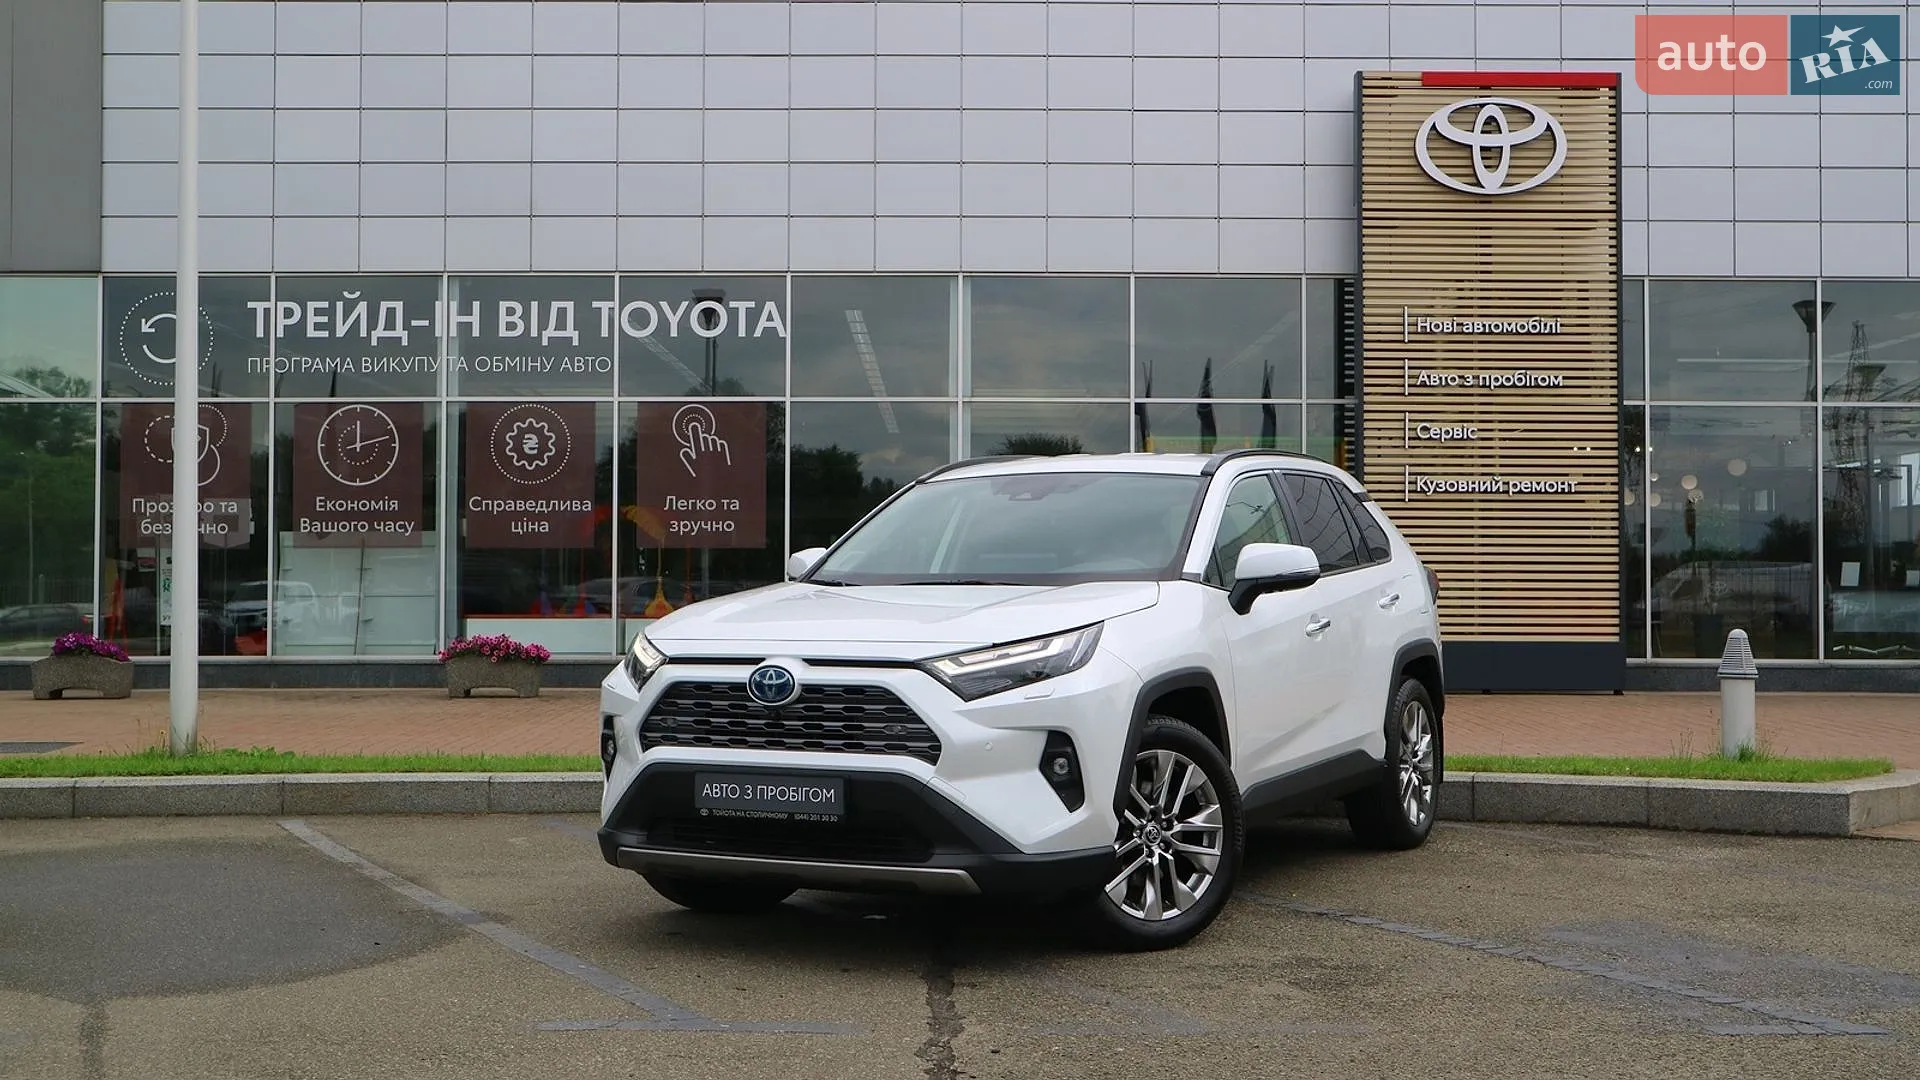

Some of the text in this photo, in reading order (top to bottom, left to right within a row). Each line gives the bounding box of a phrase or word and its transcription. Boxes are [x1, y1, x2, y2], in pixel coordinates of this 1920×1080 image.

[247, 291, 787, 346] ТРЕЙД-ІН ВІД TOYOTA
[1416, 316, 1561, 334] Нові автомобілі
[247, 355, 612, 373] ПРОГРАМА ВИКУПУ ТА ОБМІНУ АВТО
[1416, 369, 1564, 390] Авто з пробігом
[1416, 423, 1478, 443] Сервіс
[1416, 475, 1578, 497] Кузовний ремонт
[219, 502, 238, 513] та
[315, 496, 399, 512] Економія
[468, 496, 593, 515] Справедлива
[663, 496, 741, 512] Легко та
[300, 518, 415, 536] Вашого часу
[510, 517, 550, 535] ціна
[669, 518, 736, 536] зручно
[702, 783, 741, 799] АВТО
[756, 785, 836, 803] ПРОБІГОМ
